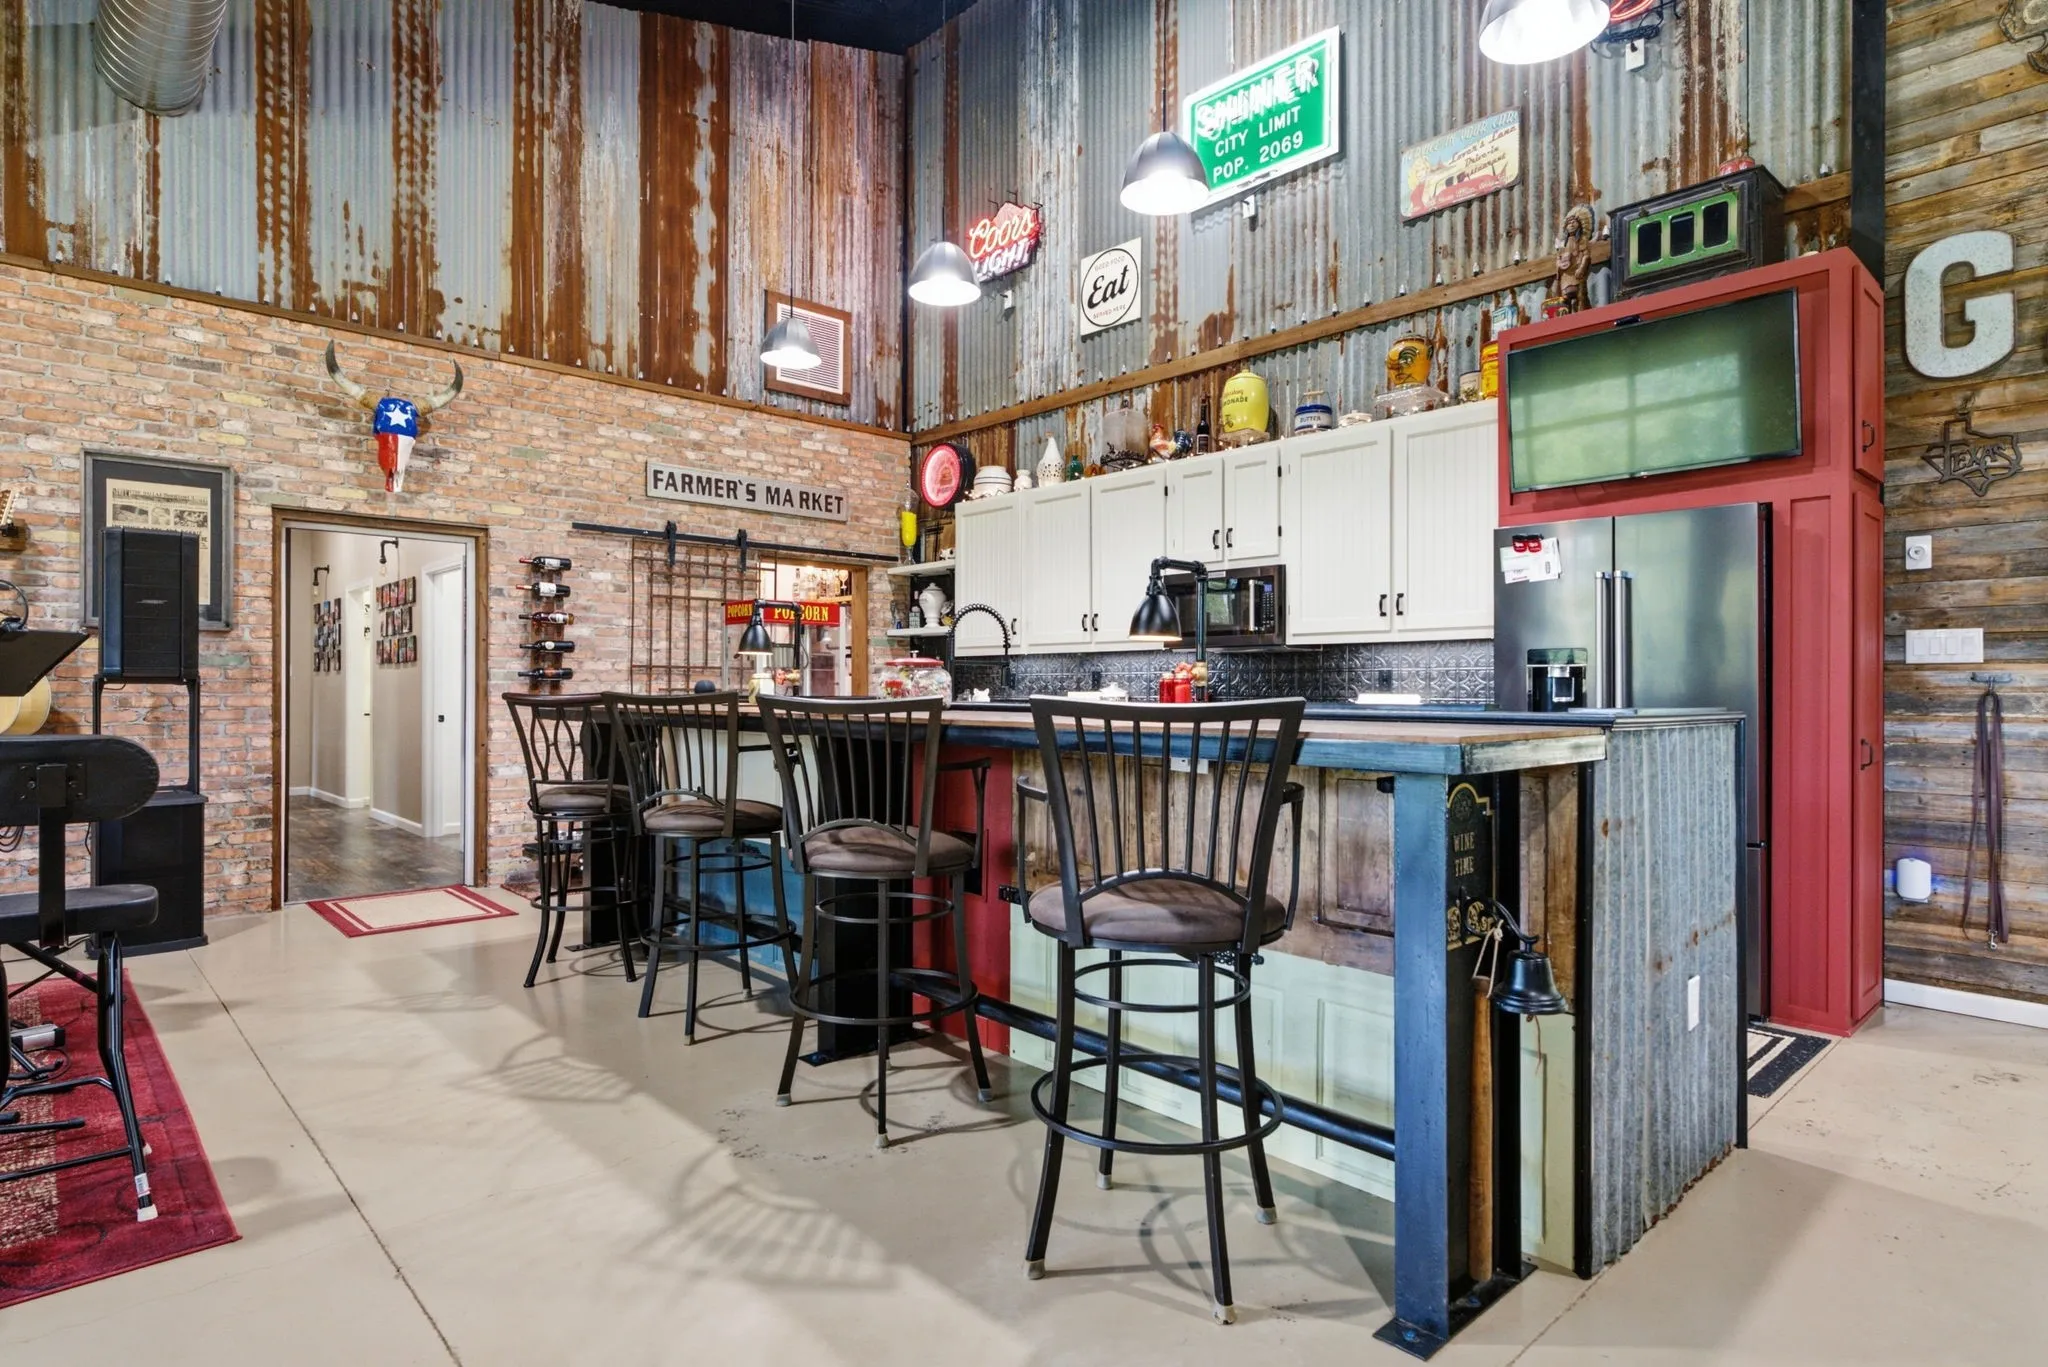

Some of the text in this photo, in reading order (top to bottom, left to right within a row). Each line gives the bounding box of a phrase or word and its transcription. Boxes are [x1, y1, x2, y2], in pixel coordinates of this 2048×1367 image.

[1214, 105, 1301, 157] CITY LIMIT
[1213, 156, 1249, 184] POP.
[1259, 130, 1303, 164] 2069
[969, 211, 1034, 259] Coors
[974, 237, 1031, 277] LIGHT
[1087, 264, 1130, 309] Eat
[1904, 229, 2017, 379] G
[652, 469, 844, 515] FARMER'S MARKET
[1453, 831, 1475, 852] WINE
[1455, 856, 1474, 877] TIME
